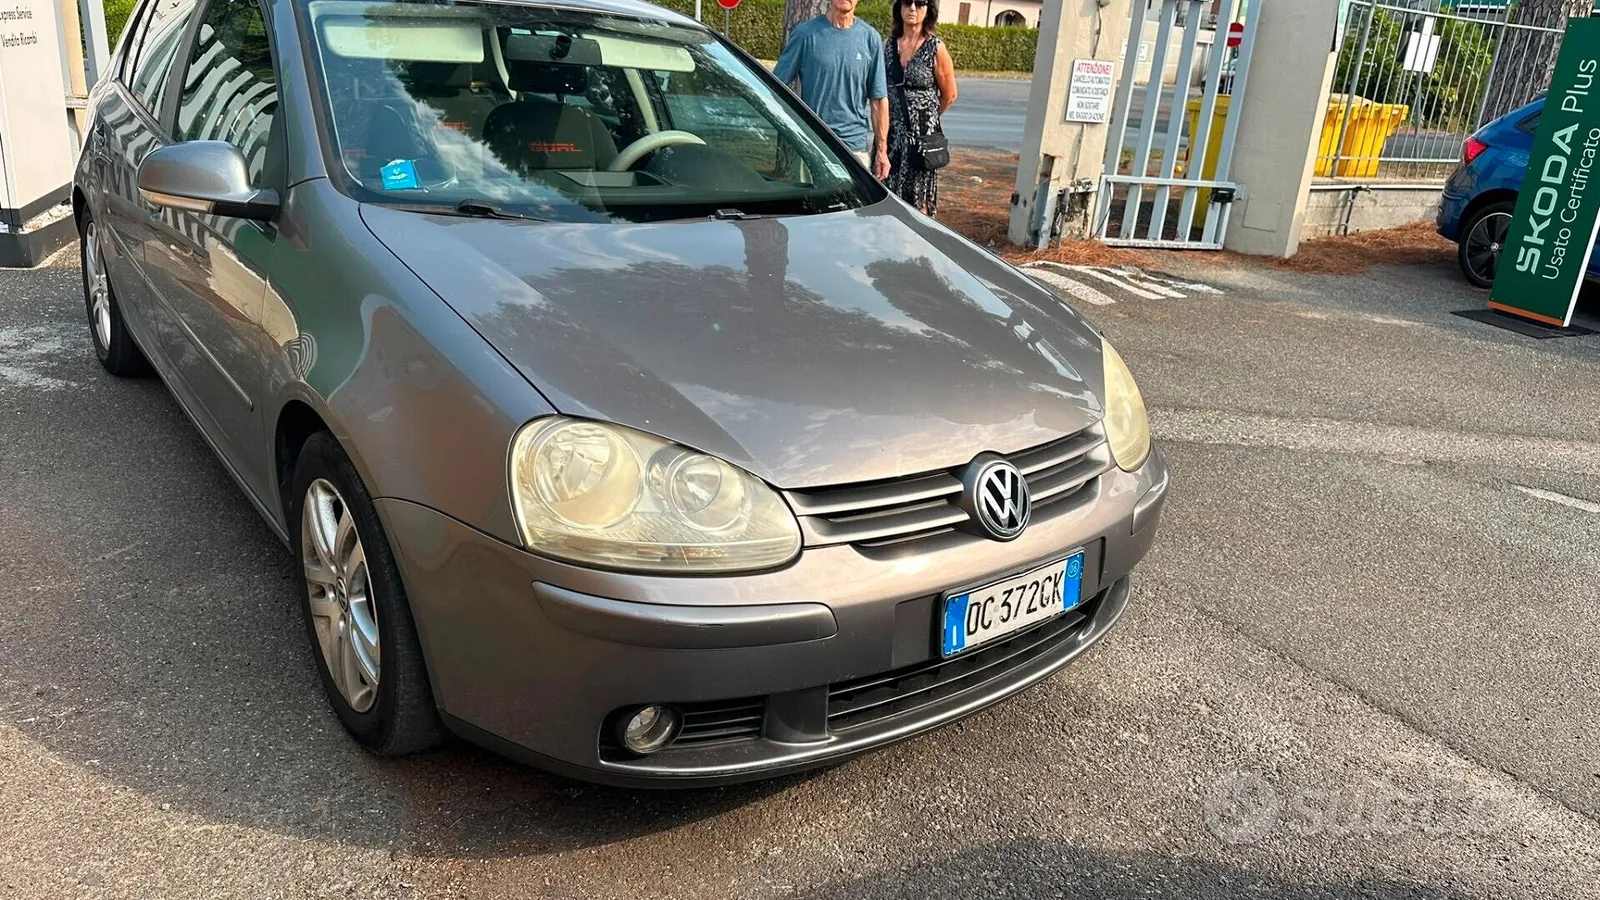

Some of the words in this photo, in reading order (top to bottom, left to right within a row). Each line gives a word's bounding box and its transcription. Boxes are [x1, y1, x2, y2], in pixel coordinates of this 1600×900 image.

[16, 6, 32, 20] Service
[0, 32, 20, 48] Vendita
[1561, 59, 1597, 113] Plus
[1542, 227, 1571, 280] Usato
[1560, 127, 1600, 223] Certificato
[966, 596, 995, 636] DC
